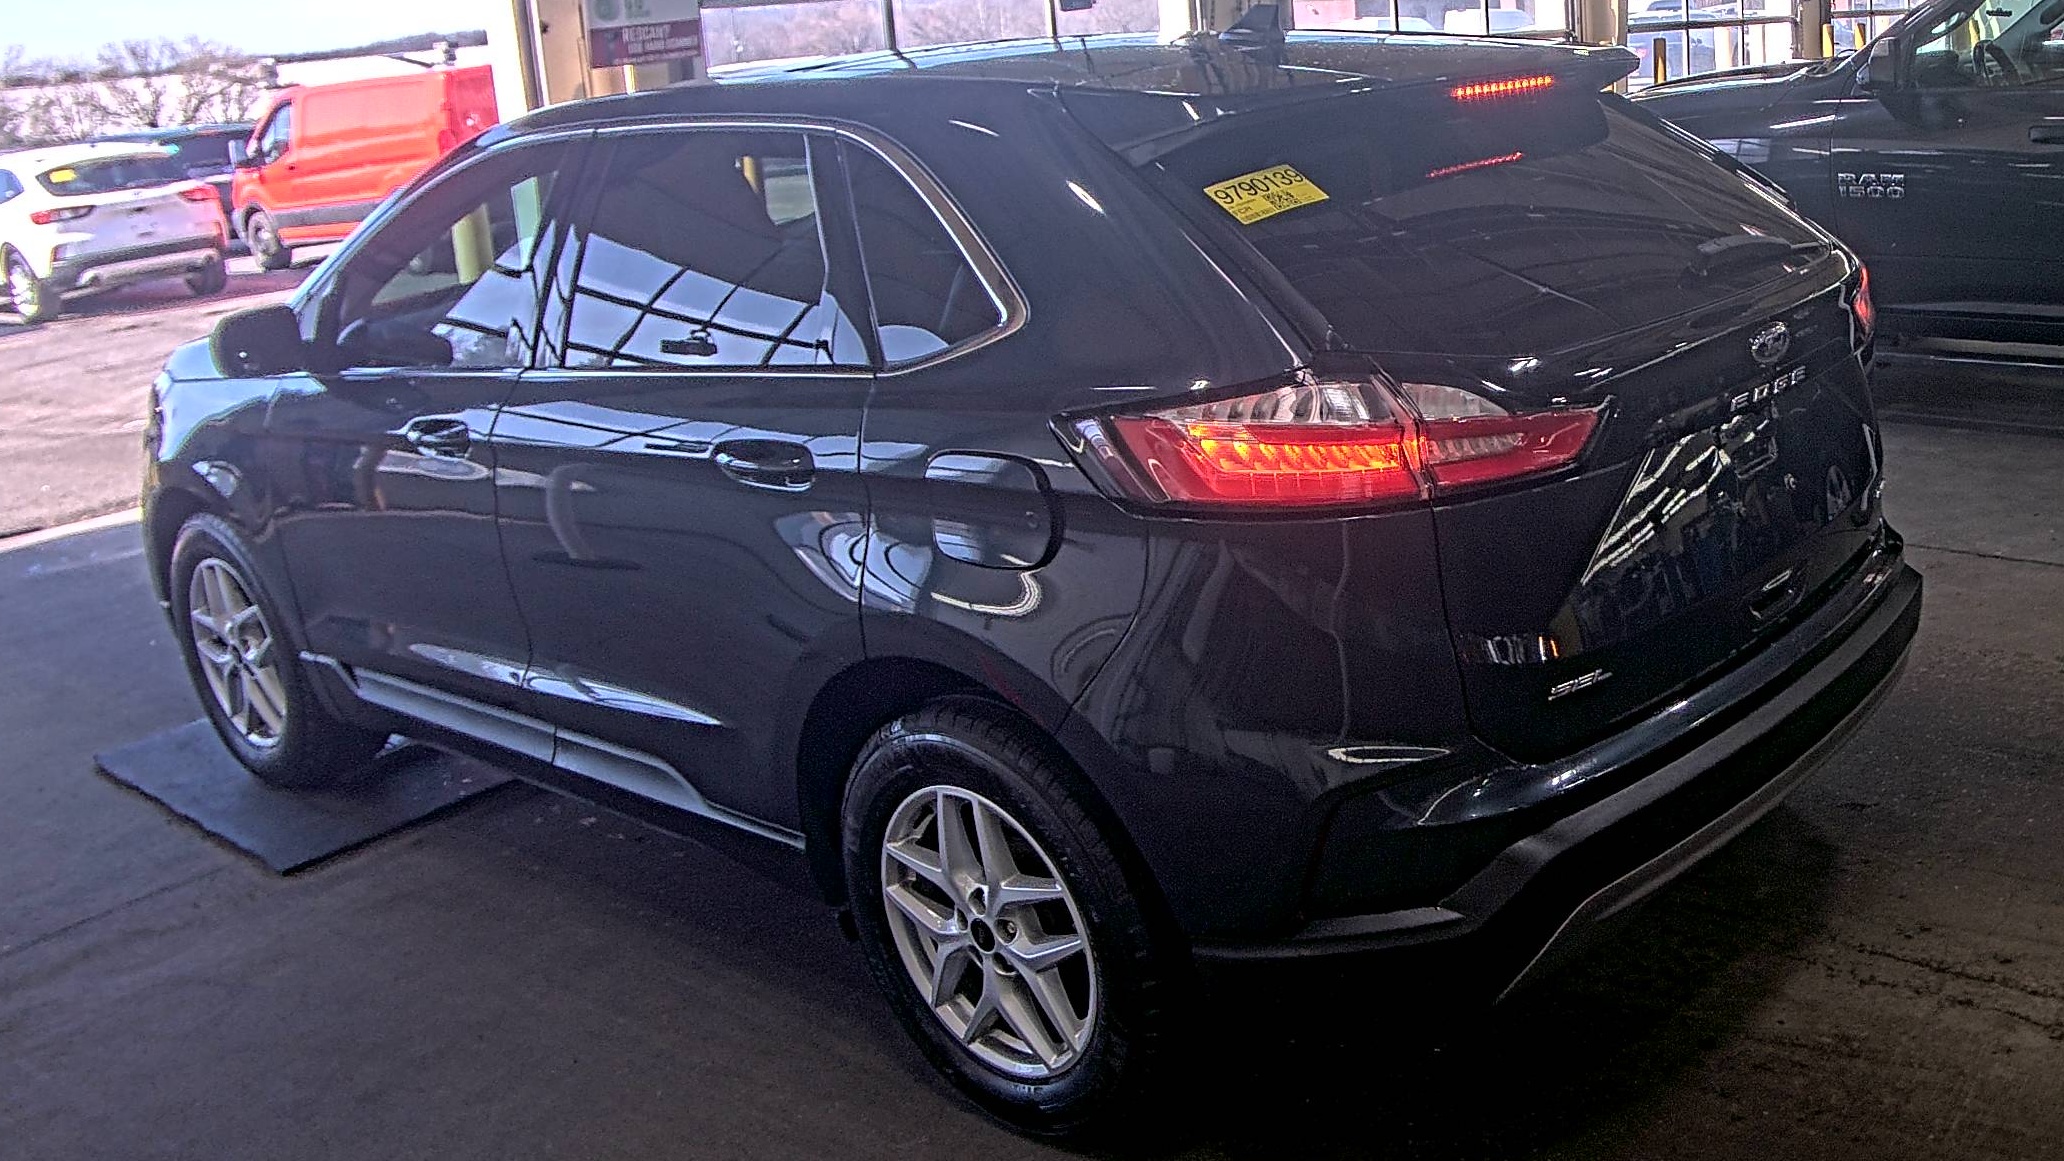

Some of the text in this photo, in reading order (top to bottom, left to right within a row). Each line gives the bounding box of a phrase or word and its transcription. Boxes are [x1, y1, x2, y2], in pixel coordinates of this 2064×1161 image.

[1214, 169, 1304, 204] 9790139
[1837, 172, 1905, 186] RAM
[1838, 185, 1905, 199] 1500
[1730, 365, 1806, 412] EDGE
[1548, 668, 1613, 701] SEL
